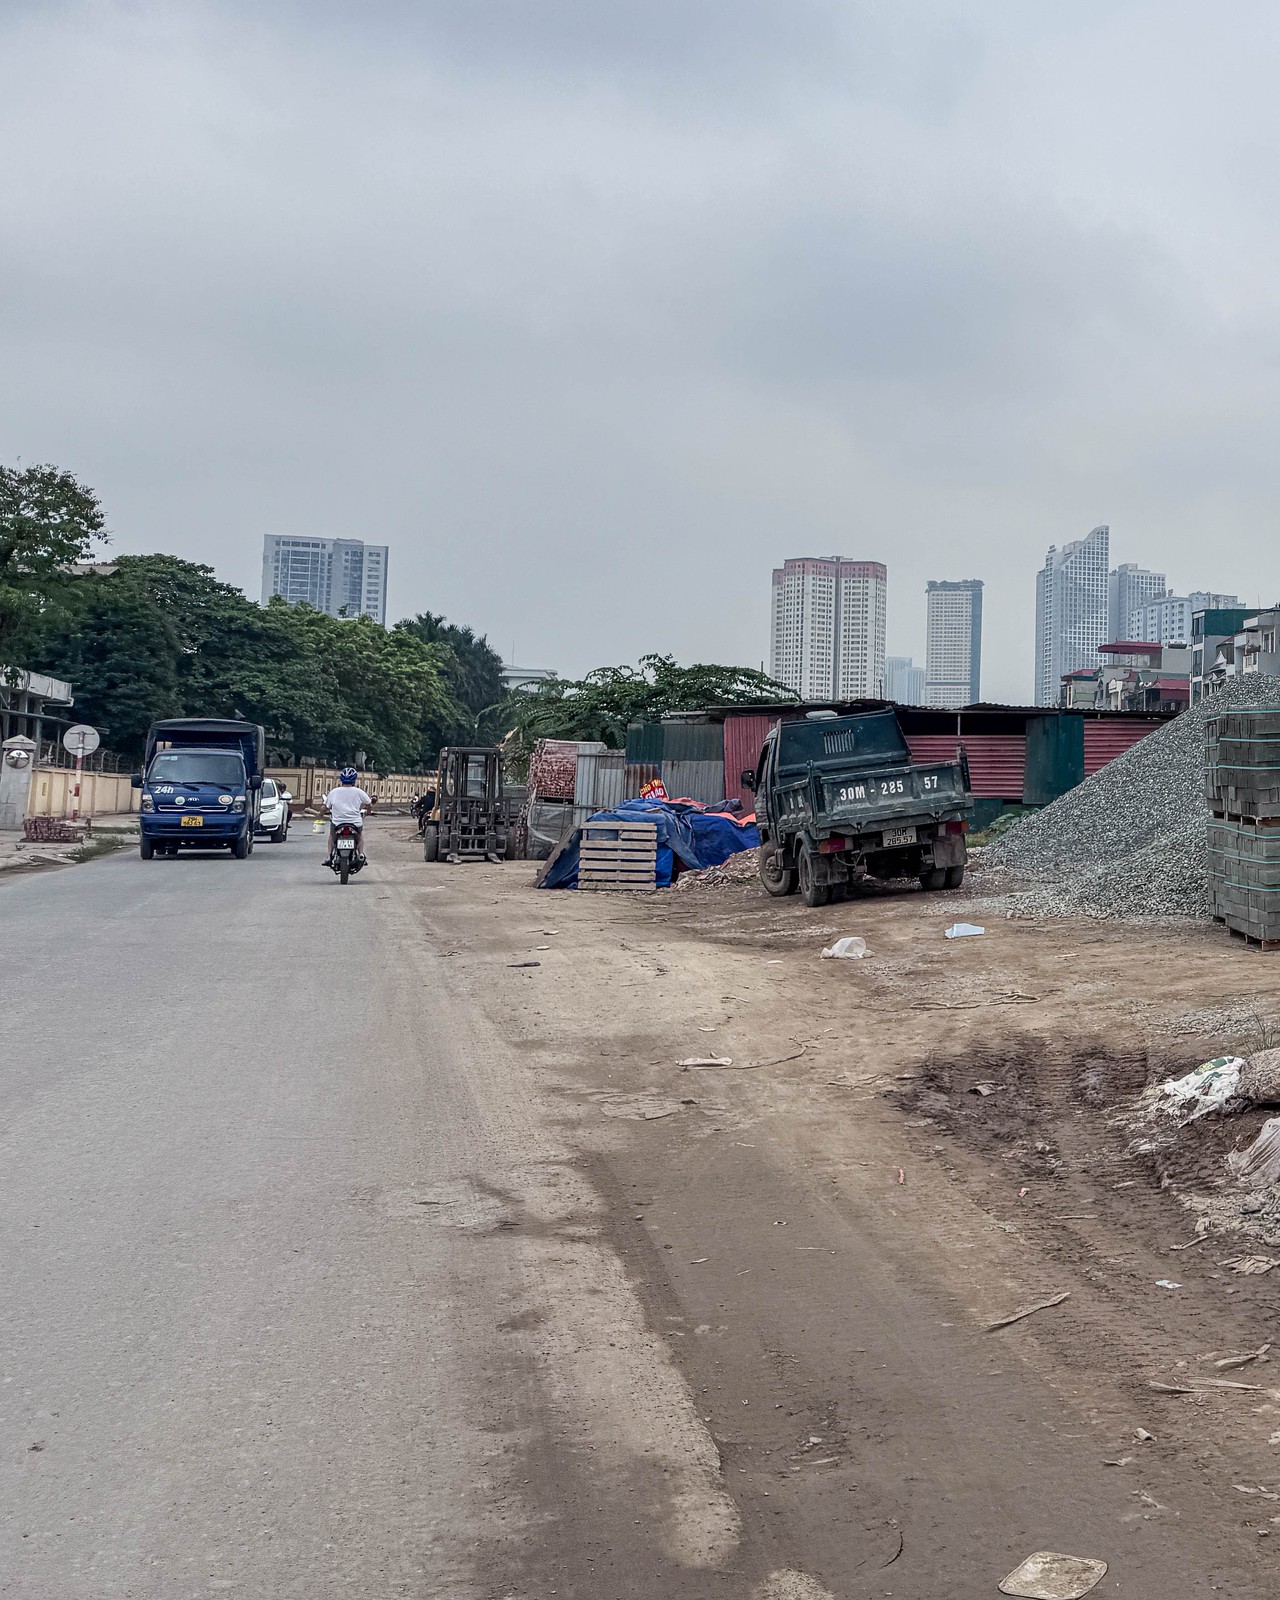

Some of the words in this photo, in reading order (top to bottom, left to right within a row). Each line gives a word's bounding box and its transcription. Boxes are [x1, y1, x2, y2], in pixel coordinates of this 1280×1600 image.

[154, 785, 174, 794] 24h
[840, 785, 866, 801] 30M
[881, 780, 904, 795] 285
[924, 775, 938, 790] 57
[886, 835, 913, 846] 285.57
